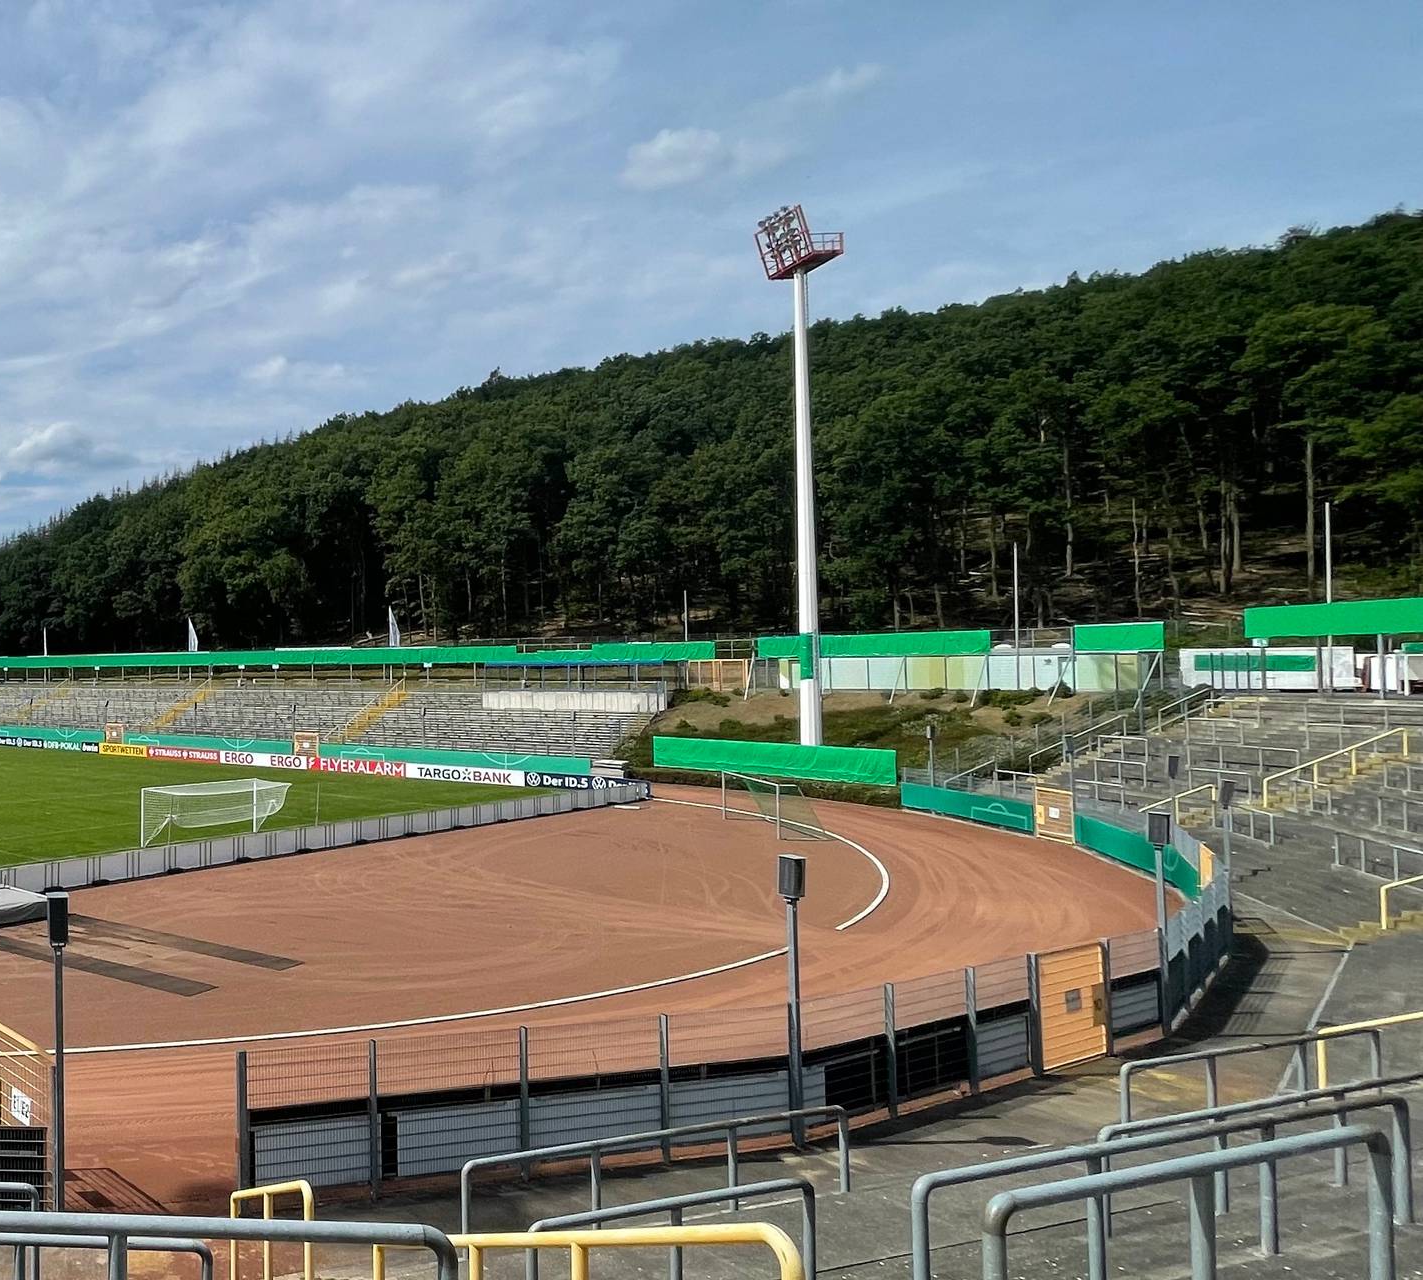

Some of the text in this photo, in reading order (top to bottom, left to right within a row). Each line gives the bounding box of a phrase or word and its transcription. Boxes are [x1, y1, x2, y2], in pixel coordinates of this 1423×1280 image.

[82, 743, 98, 752] bwin
[102, 744, 144, 755] SPORTWETTEN
[155, 748, 182, 758] STRAUSS
[188, 750, 218, 761] STRAUSS
[224, 752, 254, 764] ERGO
[270, 755, 302, 768] ERGO
[320, 758, 405, 777] FLYERALARM
[542, 775, 563, 786] Der
